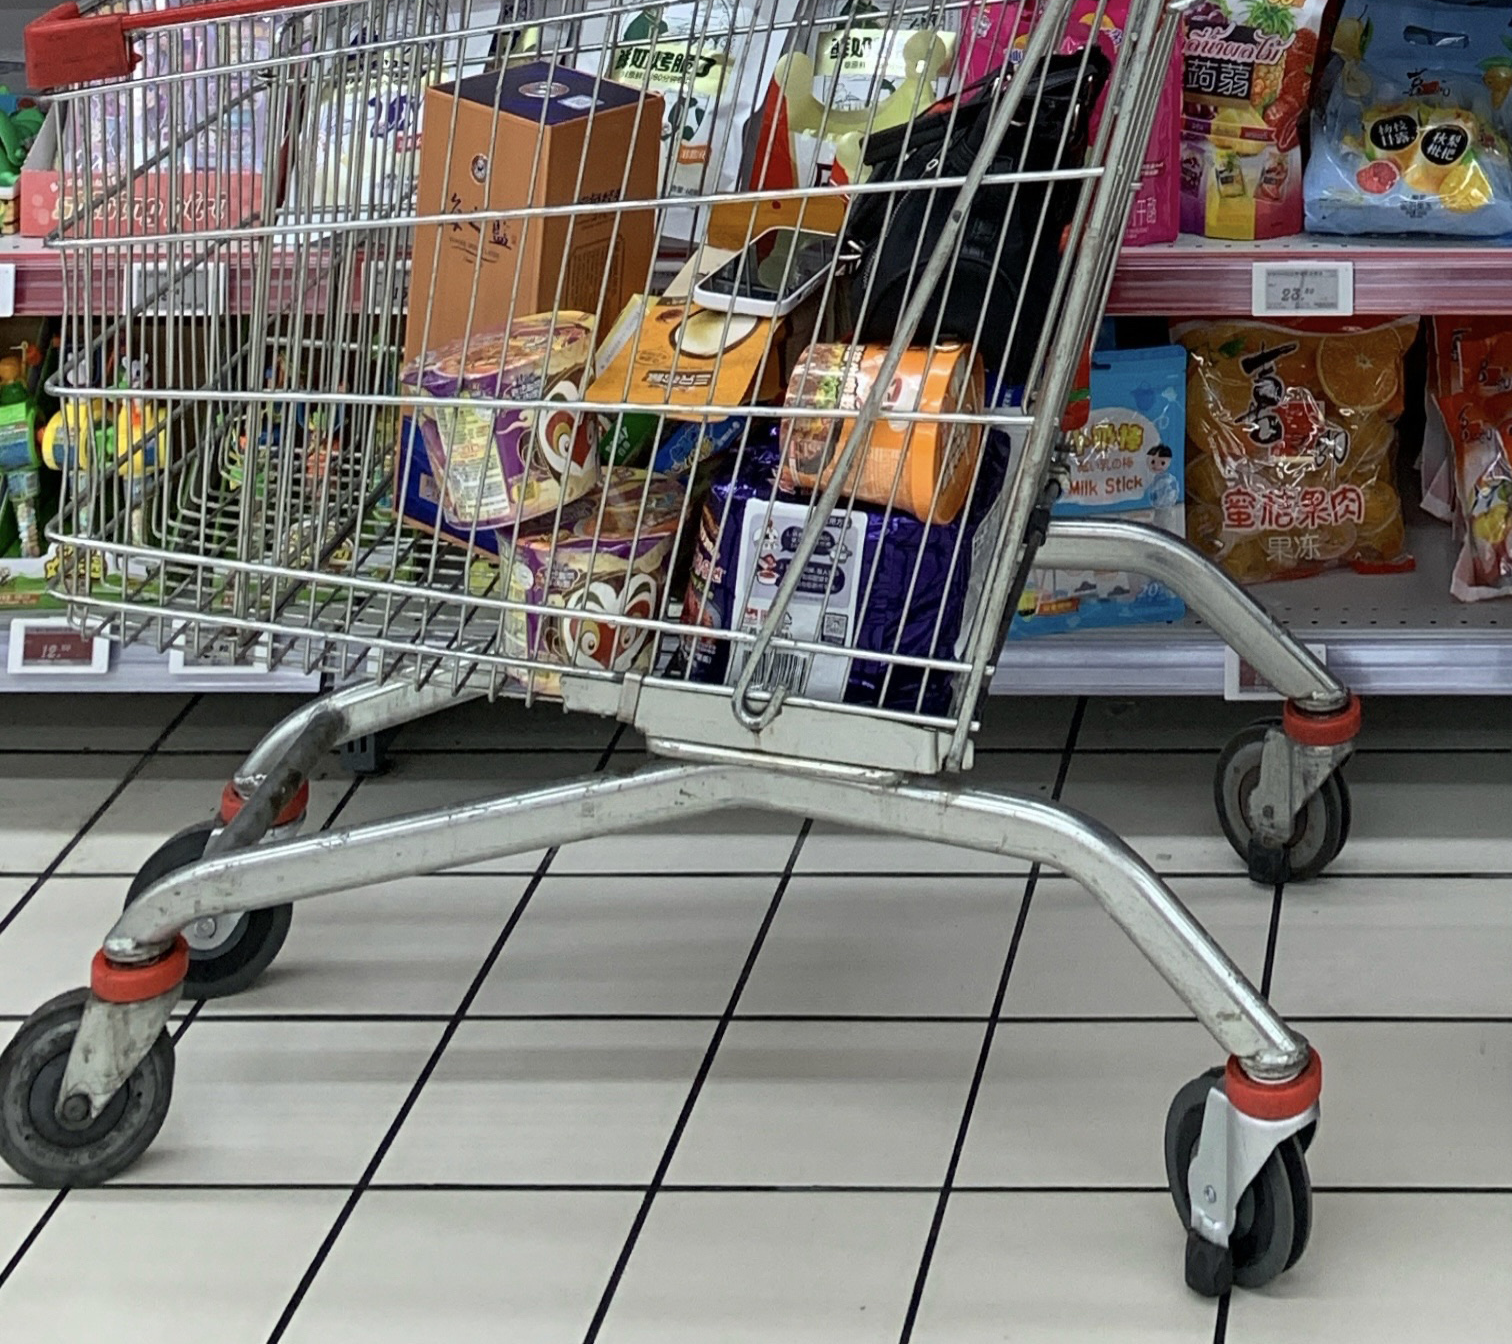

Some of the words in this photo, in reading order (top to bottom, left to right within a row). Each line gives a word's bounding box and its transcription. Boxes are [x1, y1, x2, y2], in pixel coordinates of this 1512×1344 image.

[1187, 60, 1252, 98] 蒟蒻
[1069, 479, 1099, 496] Milk
[1105, 475, 1143, 493] Stick
[1222, 487, 1365, 529] 蜜桔果肉
[1265, 535, 1321, 563] 果冻
